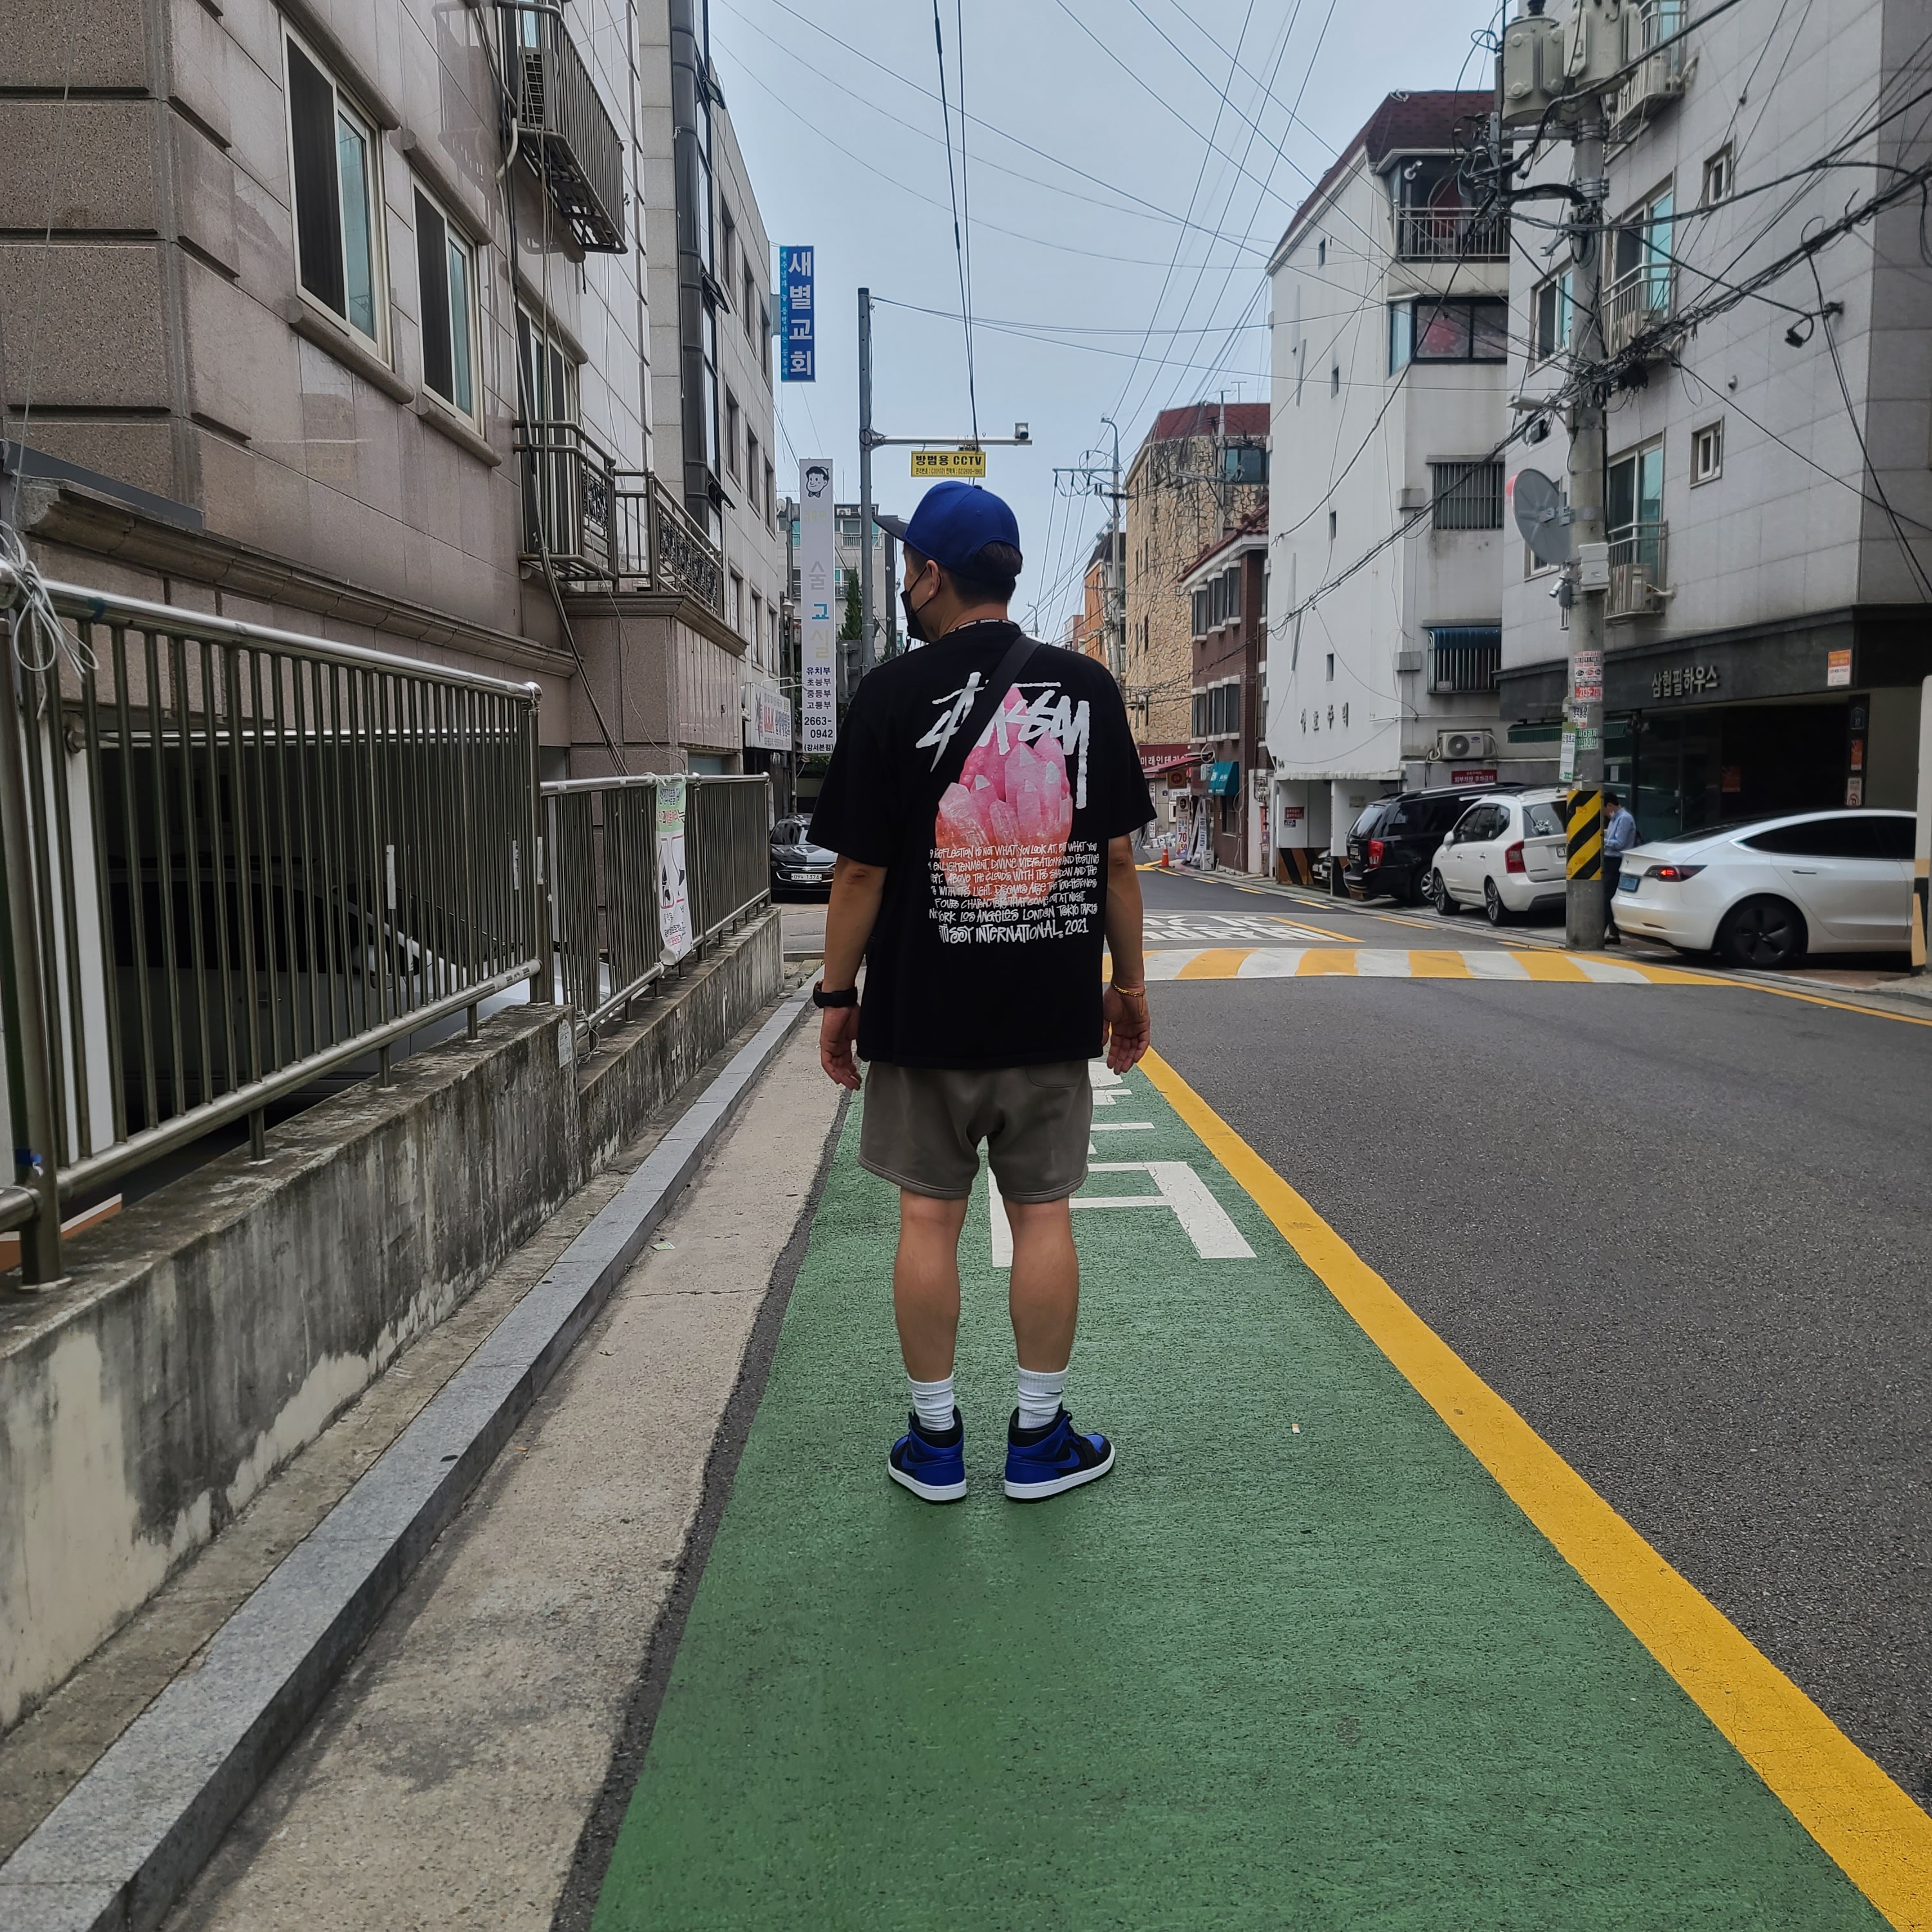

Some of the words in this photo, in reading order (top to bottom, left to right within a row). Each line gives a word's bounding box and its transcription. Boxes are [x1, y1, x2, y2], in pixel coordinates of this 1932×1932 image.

[788, 252, 813, 375] 새별교회
[916, 455, 949, 466] 방범용
[953, 455, 982, 465] CCTV
[806, 667, 831, 676] 유치부
[806, 690, 831, 698] 중등부
[806, 701, 831, 710] 고등부
[804, 717, 832, 726] 2663-
[810, 729, 833, 738] 0942
[934, 846, 974, 858] REFLECTION
[975, 847, 982, 857] IS
[983, 846, 995, 856] NOT
[995, 844, 1018, 856] WHAT
[1018, 845, 1030, 857] YOU
[1030, 844, 1046, 855] LOOK
[1068, 841, 1087, 853] WHAT
[1087, 842, 1097, 852] YOU
[991, 857, 1017, 869] DIVINE
[1062, 855, 1074, 866] AND
[948, 873, 971, 884] ABOVE
[972, 872, 984, 884] THE
[985, 871, 1011, 881] CLOUDS
[1012, 868, 1034, 881] WITH
[1074, 866, 1086, 876] AND
[1086, 865, 1097, 876] THE
[939, 886, 956, 897] WITH
[1028, 882, 1046, 895] ARE
[1046, 882, 1057, 892] THE
[1007, 896, 1028, 907] THAT
[1027, 896, 1048, 907] COME
[1059, 893, 1069, 904] AT
[938, 911, 956, 924] YORK
[960, 911, 976, 922] LOS
[976, 909, 1019, 923] ANGELES
[1023, 905, 1055, 920] LONDON
[1056, 904, 1079, 917] TOKYO
[1080, 903, 1098, 916] PARIS
[1065, 918, 1089, 935] 2021
